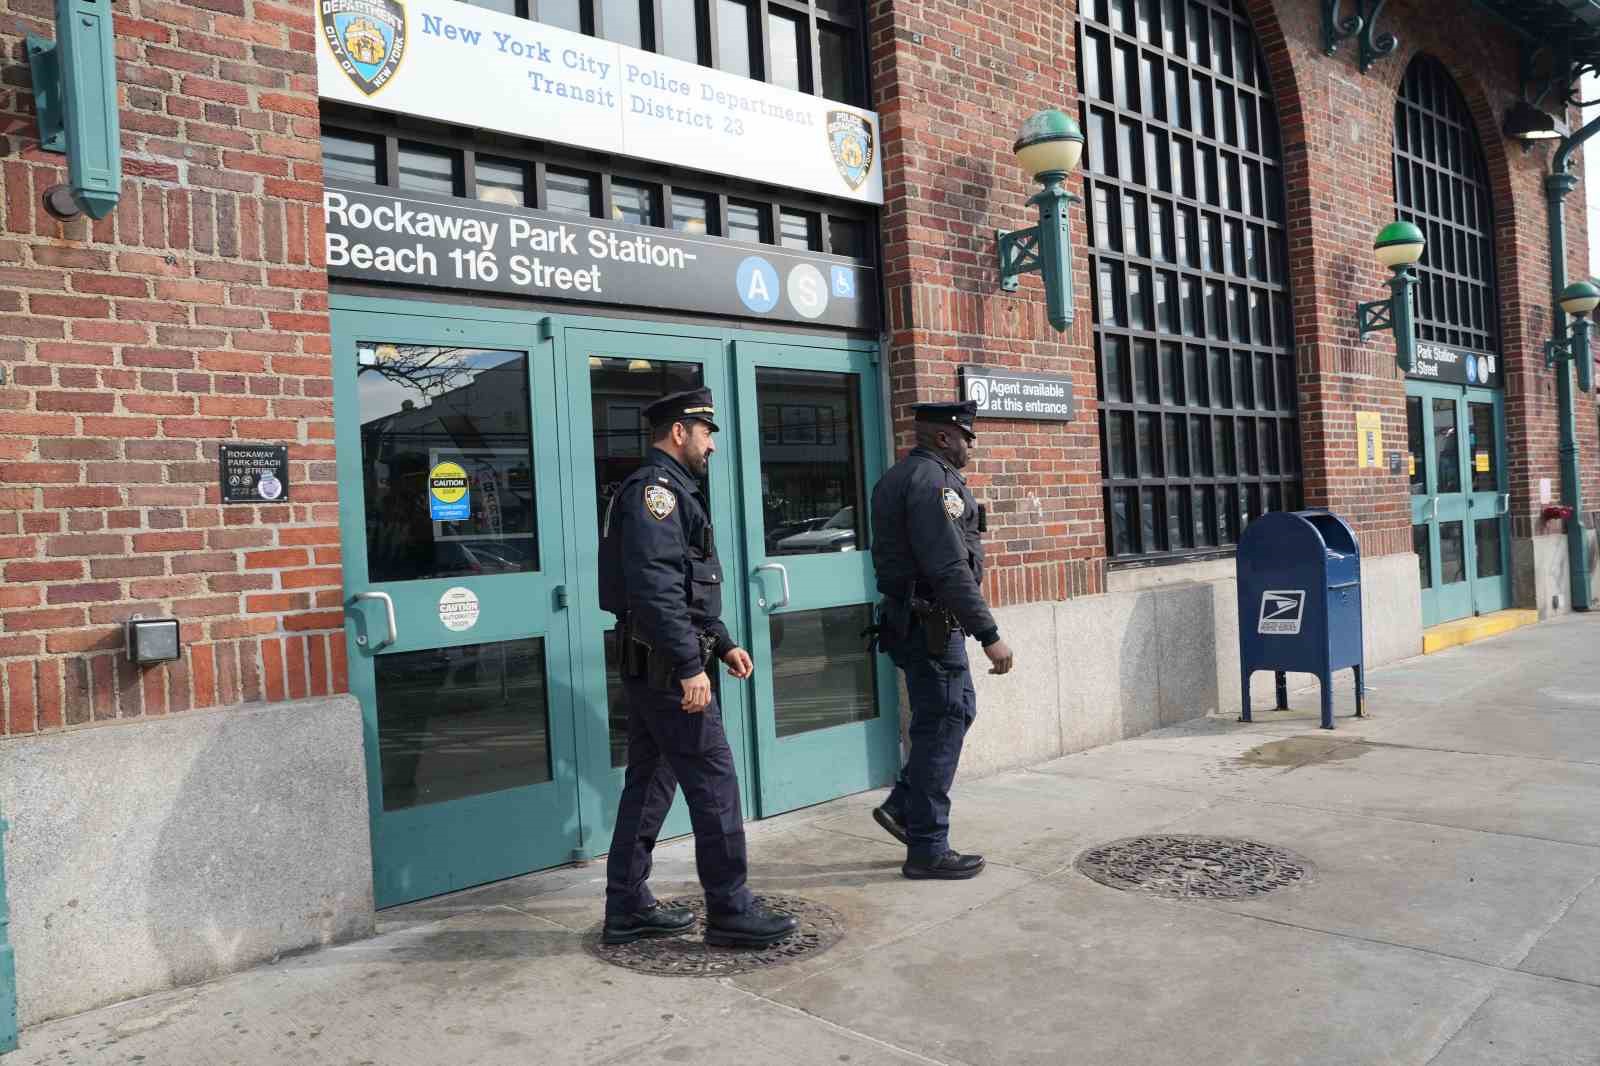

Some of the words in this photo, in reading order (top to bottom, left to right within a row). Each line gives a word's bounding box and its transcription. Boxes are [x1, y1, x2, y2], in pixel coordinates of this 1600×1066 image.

[325, 25, 344, 55] CITY
[372, 66, 392, 88] NEW
[389, 36, 404, 65] YORK
[421, 13, 481, 46] New
[493, 31, 551, 63] York
[562, 49, 611, 80] City
[627, 63, 691, 96] Police
[700, 83, 815, 126] Department
[528, 70, 615, 108] Transit
[631, 95, 713, 130] District
[723, 116, 744, 136] 23
[324, 191, 499, 250] Rockaway
[509, 219, 578, 256] Park
[325, 233, 438, 276] Beach
[448, 248, 499, 282] 116
[510, 255, 602, 293] Street
[748, 268, 770, 302] A
[796, 273, 817, 307] S
[1417, 361, 1439, 377] Street
[990, 380, 1020, 397] Agent
[1023, 383, 1064, 397] available
[990, 400, 1002, 411] at
[1005, 399, 1023, 412] this
[1025, 400, 1067, 413] entrance
[433, 479, 464, 487] CAUTION
